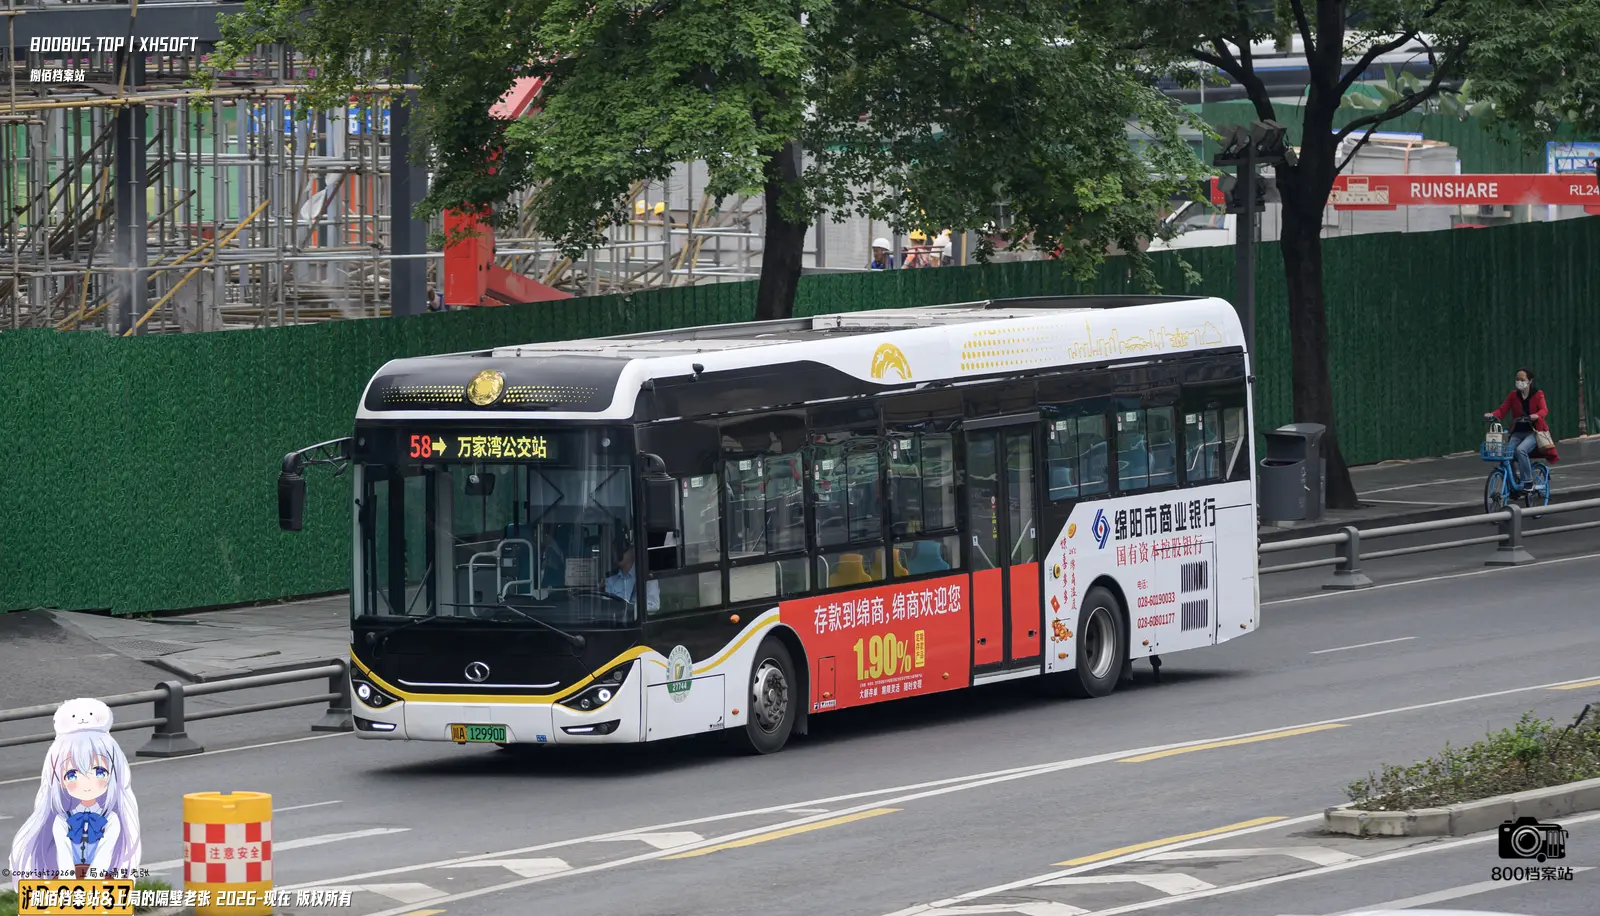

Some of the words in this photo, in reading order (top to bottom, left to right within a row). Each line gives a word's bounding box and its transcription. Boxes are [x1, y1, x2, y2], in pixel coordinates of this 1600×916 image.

[1410, 182, 1498, 198] RUNSHARE
[410, 435, 432, 458] 58
[457, 436, 547, 458] 万家湾公交站
[1114, 498, 1216, 540] 绵阳市商业银行
[1116, 534, 1203, 567] 国有资本控股银行
[853, 633, 911, 680] 1.90%
[672, 682, 687, 692] 27744
[210, 846, 259, 859] 注意安全
